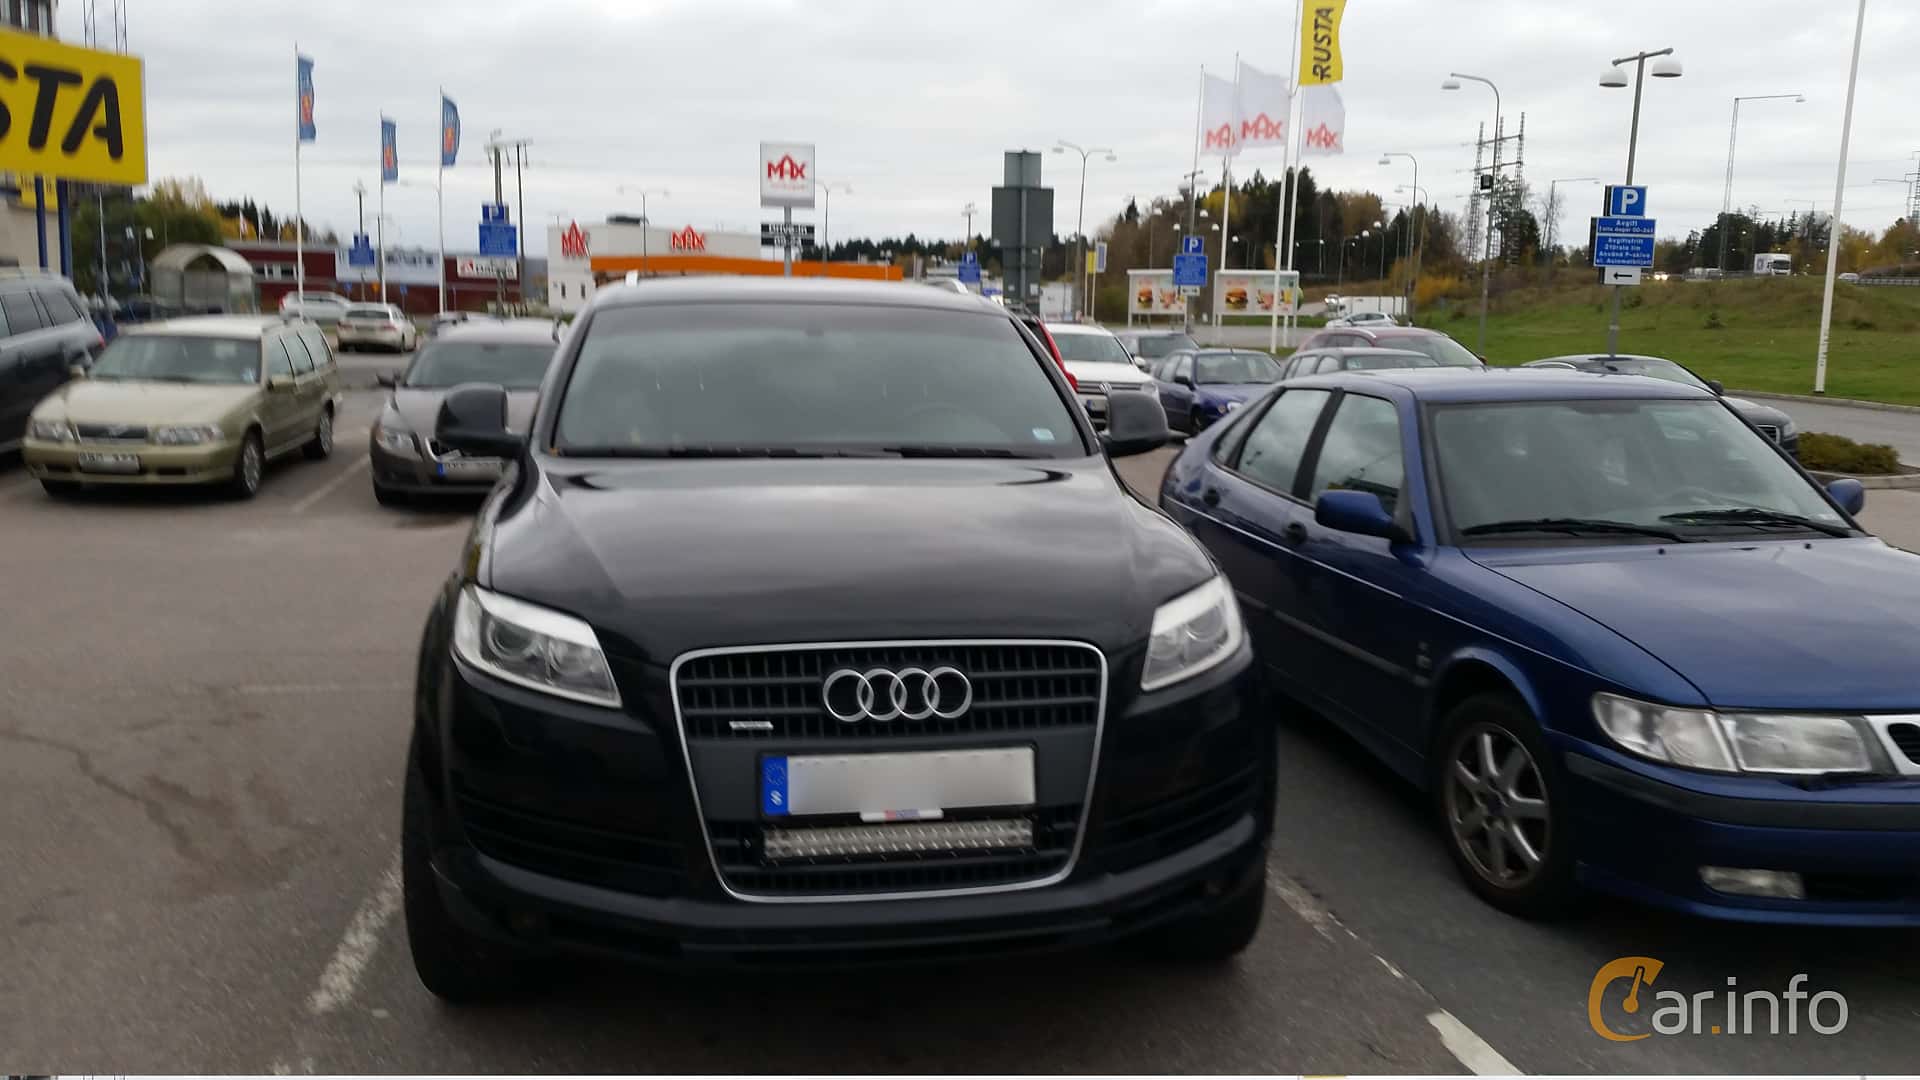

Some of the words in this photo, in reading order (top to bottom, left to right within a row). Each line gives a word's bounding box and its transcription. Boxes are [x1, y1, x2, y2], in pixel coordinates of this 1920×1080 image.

[1312, 7, 1334, 82] RUSTA
[1241, 112, 1282, 140] MAX
[1306, 122, 1337, 148] MAX
[768, 154, 806, 179] MAX
[1621, 189, 1639, 214] P
[561, 218, 590, 257] MAX
[671, 225, 706, 251] MAX
[1189, 237, 1198, 251] P
